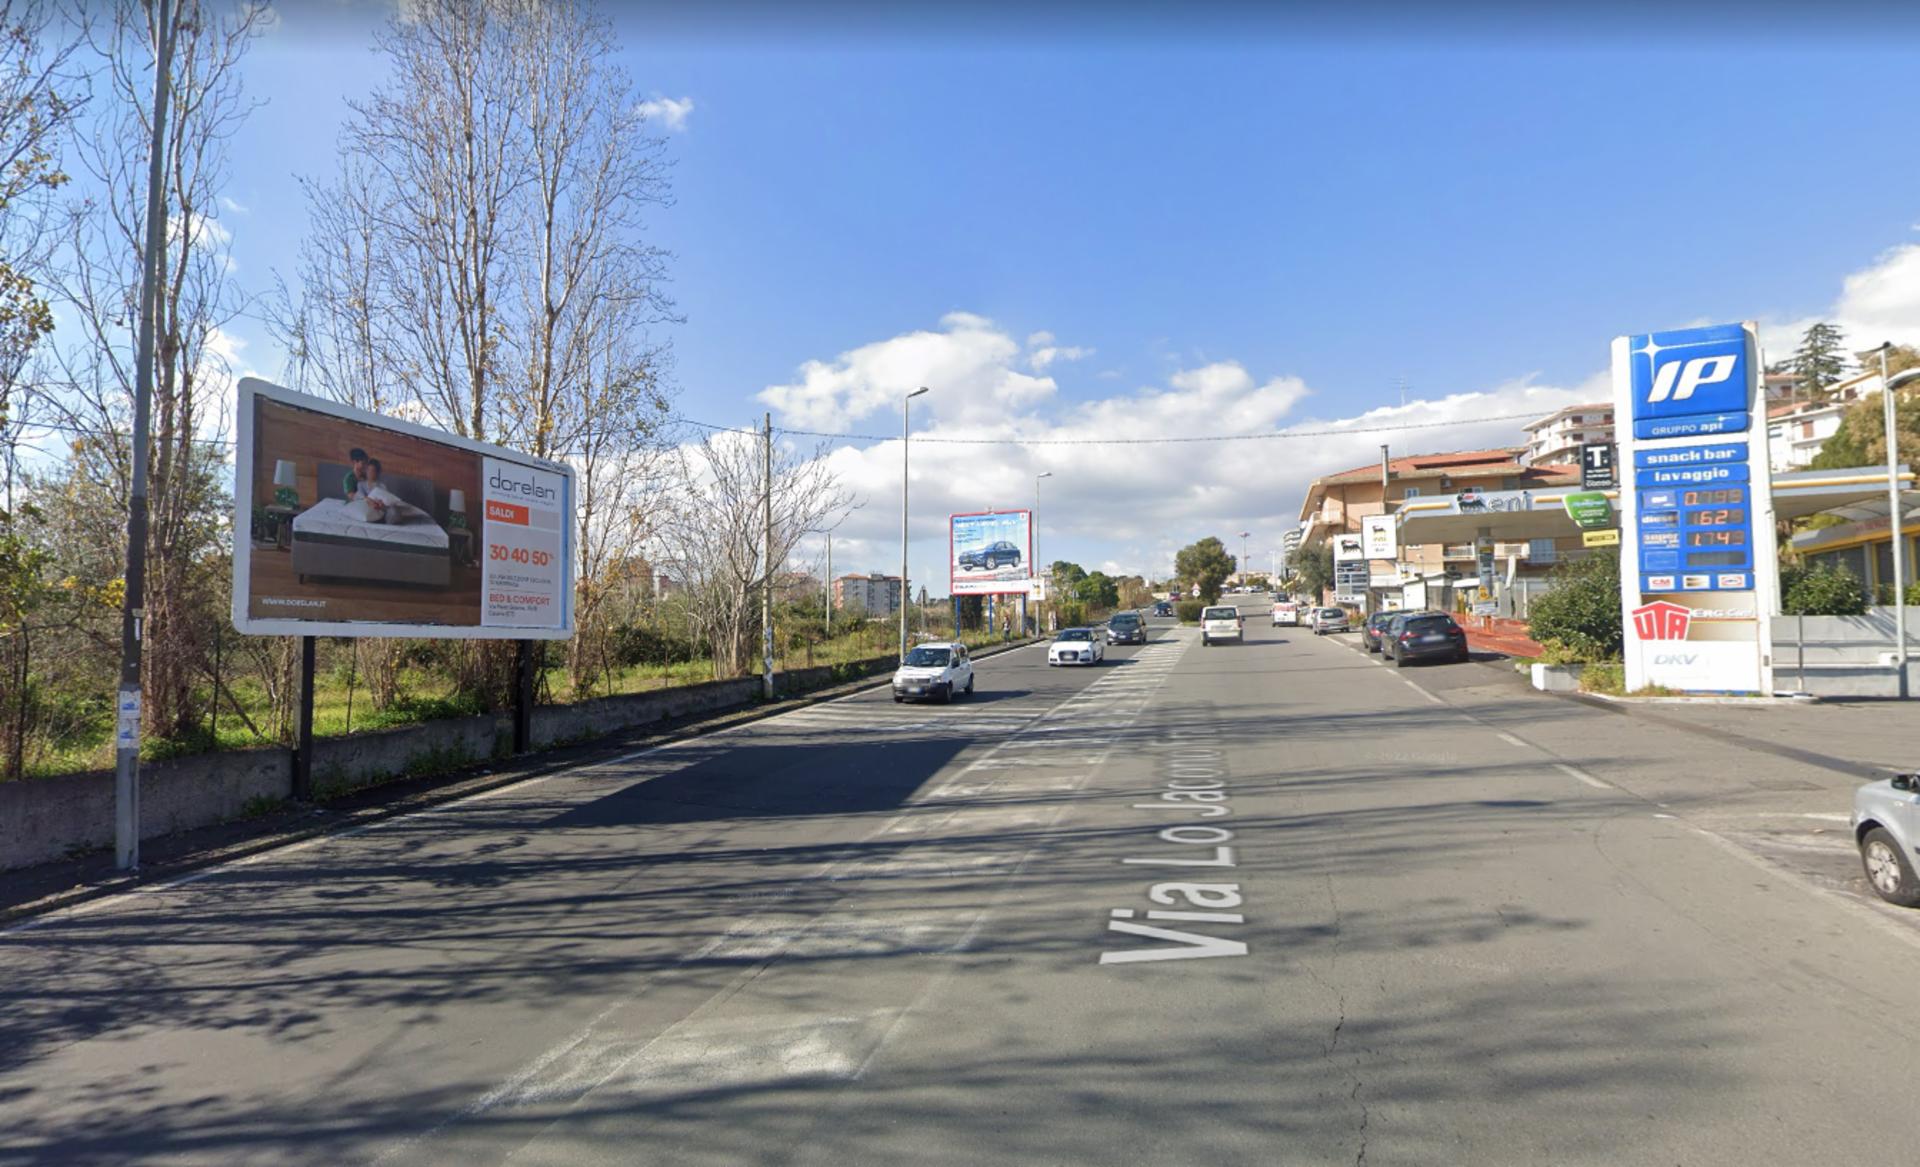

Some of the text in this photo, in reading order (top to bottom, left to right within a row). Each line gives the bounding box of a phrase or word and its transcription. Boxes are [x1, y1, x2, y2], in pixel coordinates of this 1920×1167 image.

[1647, 354, 1737, 403] IP
[1651, 422, 1724, 435] GRUPPO api
[1586, 446, 1607, 467] T
[1647, 447, 1737, 464] snack bar
[489, 467, 555, 500] dorelan
[1655, 467, 1729, 482] lavaggio
[1488, 490, 1533, 513] eni
[489, 506, 515, 519] SALDI
[490, 543, 509, 561] 30
[511, 547, 529, 564] 40
[489, 593, 505, 603] BED
[513, 595, 551, 606] COMFORT
[1632, 601, 1691, 640] UTA
[1654, 654, 1699, 665] DKV
